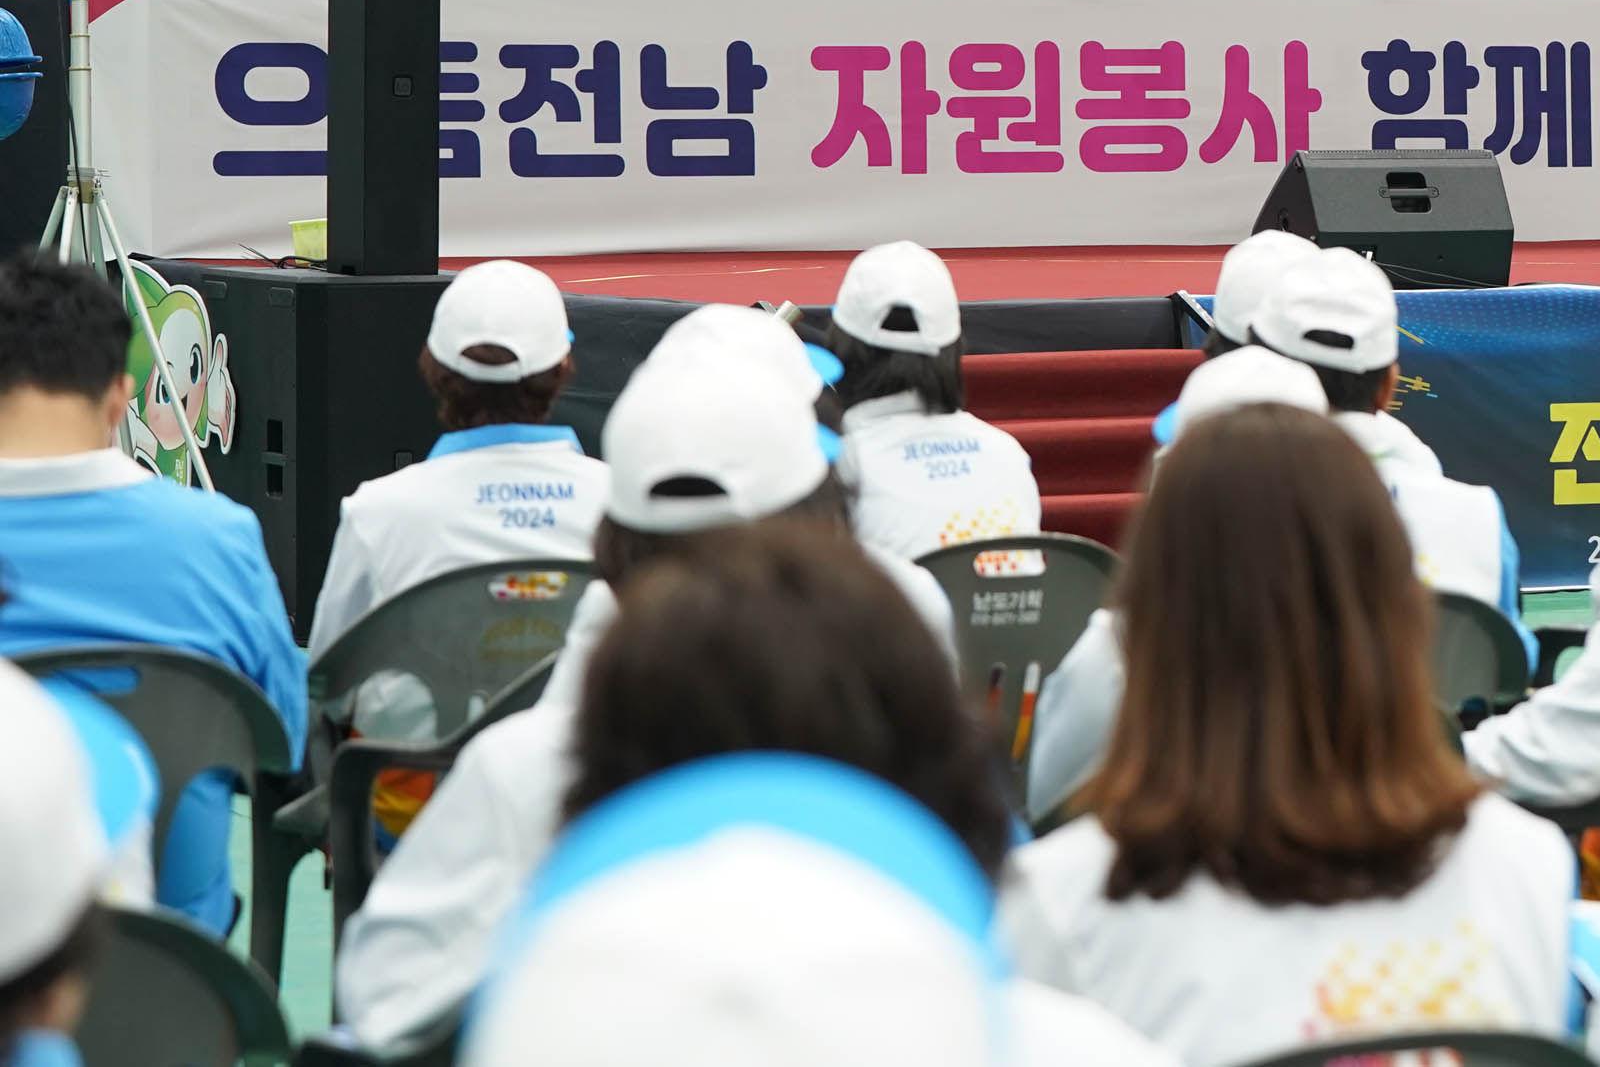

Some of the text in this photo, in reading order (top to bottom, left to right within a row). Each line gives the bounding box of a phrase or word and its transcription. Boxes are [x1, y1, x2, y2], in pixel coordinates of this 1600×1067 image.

[810, 40, 1323, 175] 자원봉사
[904, 437, 980, 459] JEONNAM
[925, 460, 971, 479] 2024
[475, 483, 575, 504] JEONNAM
[499, 506, 556, 528] 2024
